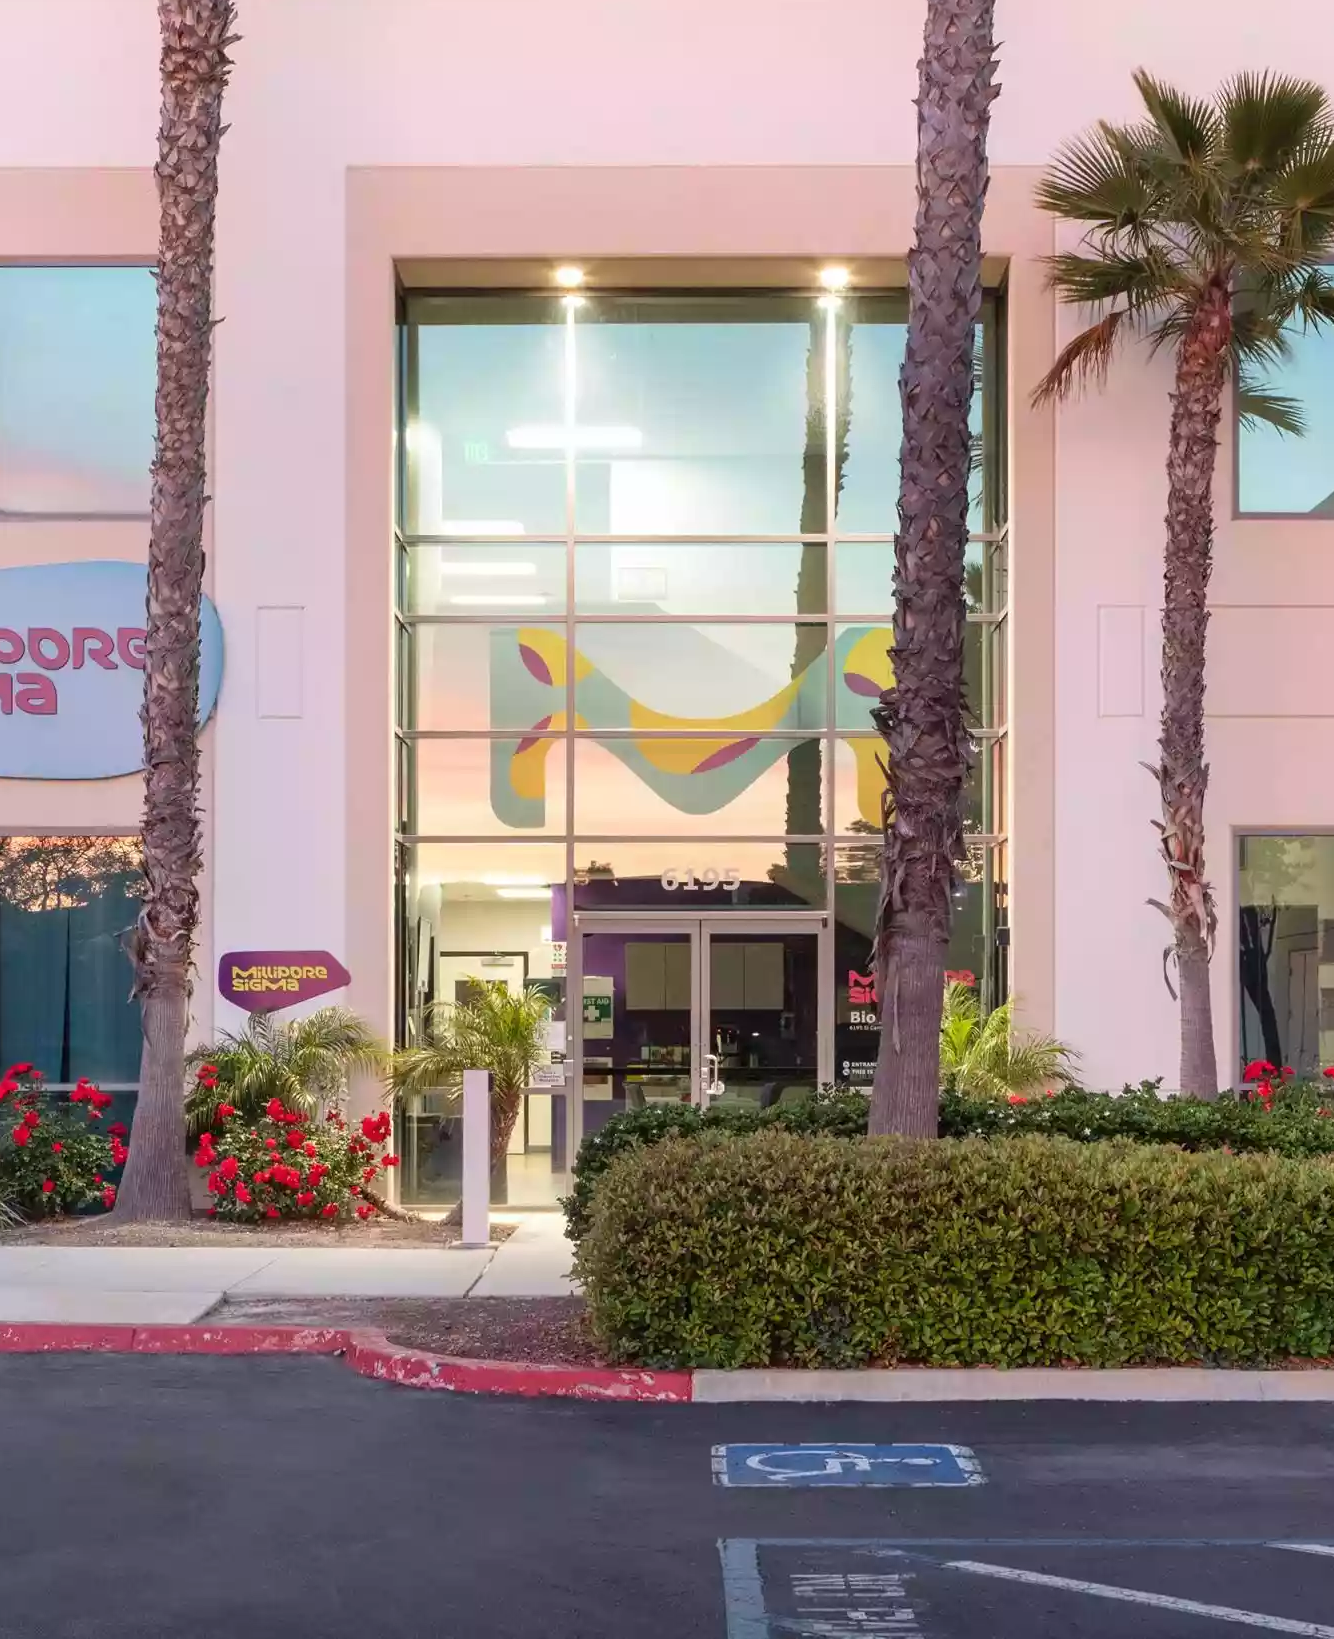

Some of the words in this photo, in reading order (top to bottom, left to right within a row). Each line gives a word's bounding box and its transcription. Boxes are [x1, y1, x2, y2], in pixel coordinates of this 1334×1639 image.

[660, 867, 741, 891] 6195
[596, 997, 609, 1005] AID
[850, 1010, 876, 1023] Bio
